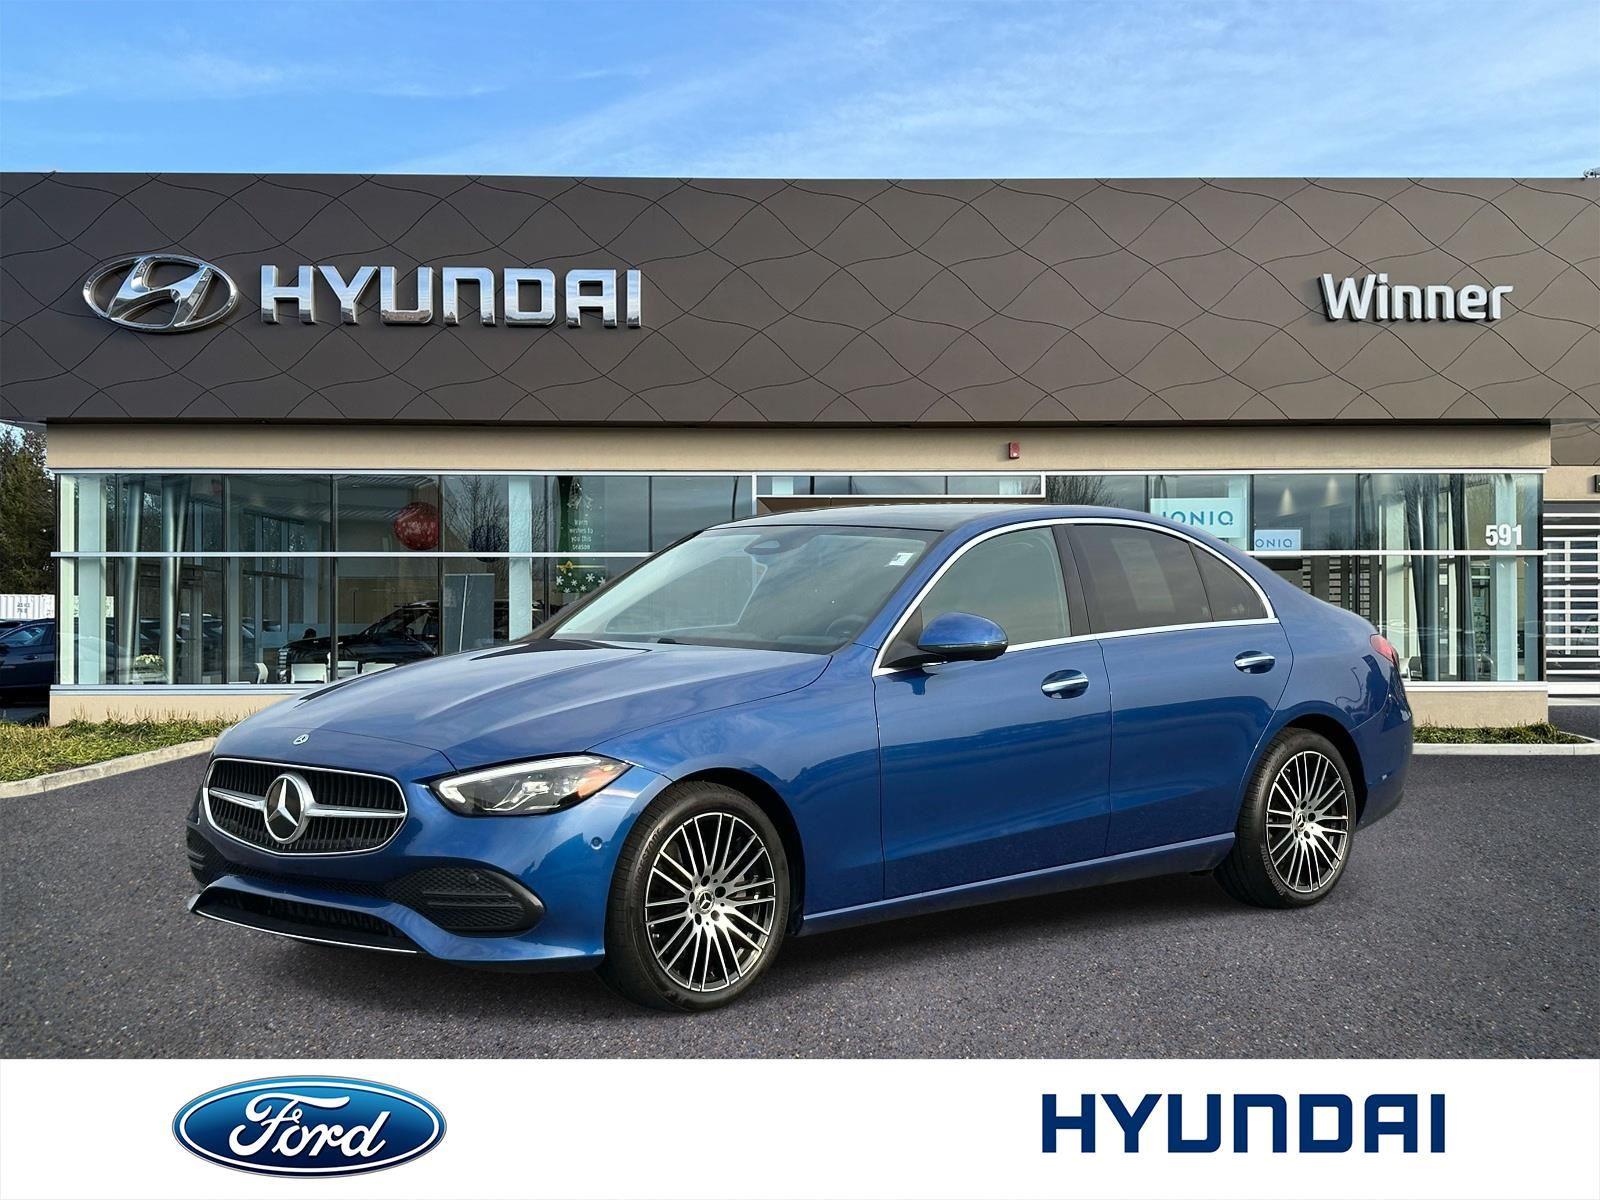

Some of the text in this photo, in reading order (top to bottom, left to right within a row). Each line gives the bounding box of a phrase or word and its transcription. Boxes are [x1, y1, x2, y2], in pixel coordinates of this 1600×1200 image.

[259, 264, 643, 329] HYUNDAI
[1319, 272, 1514, 320] Winner
[1486, 524, 1522, 546] 591
